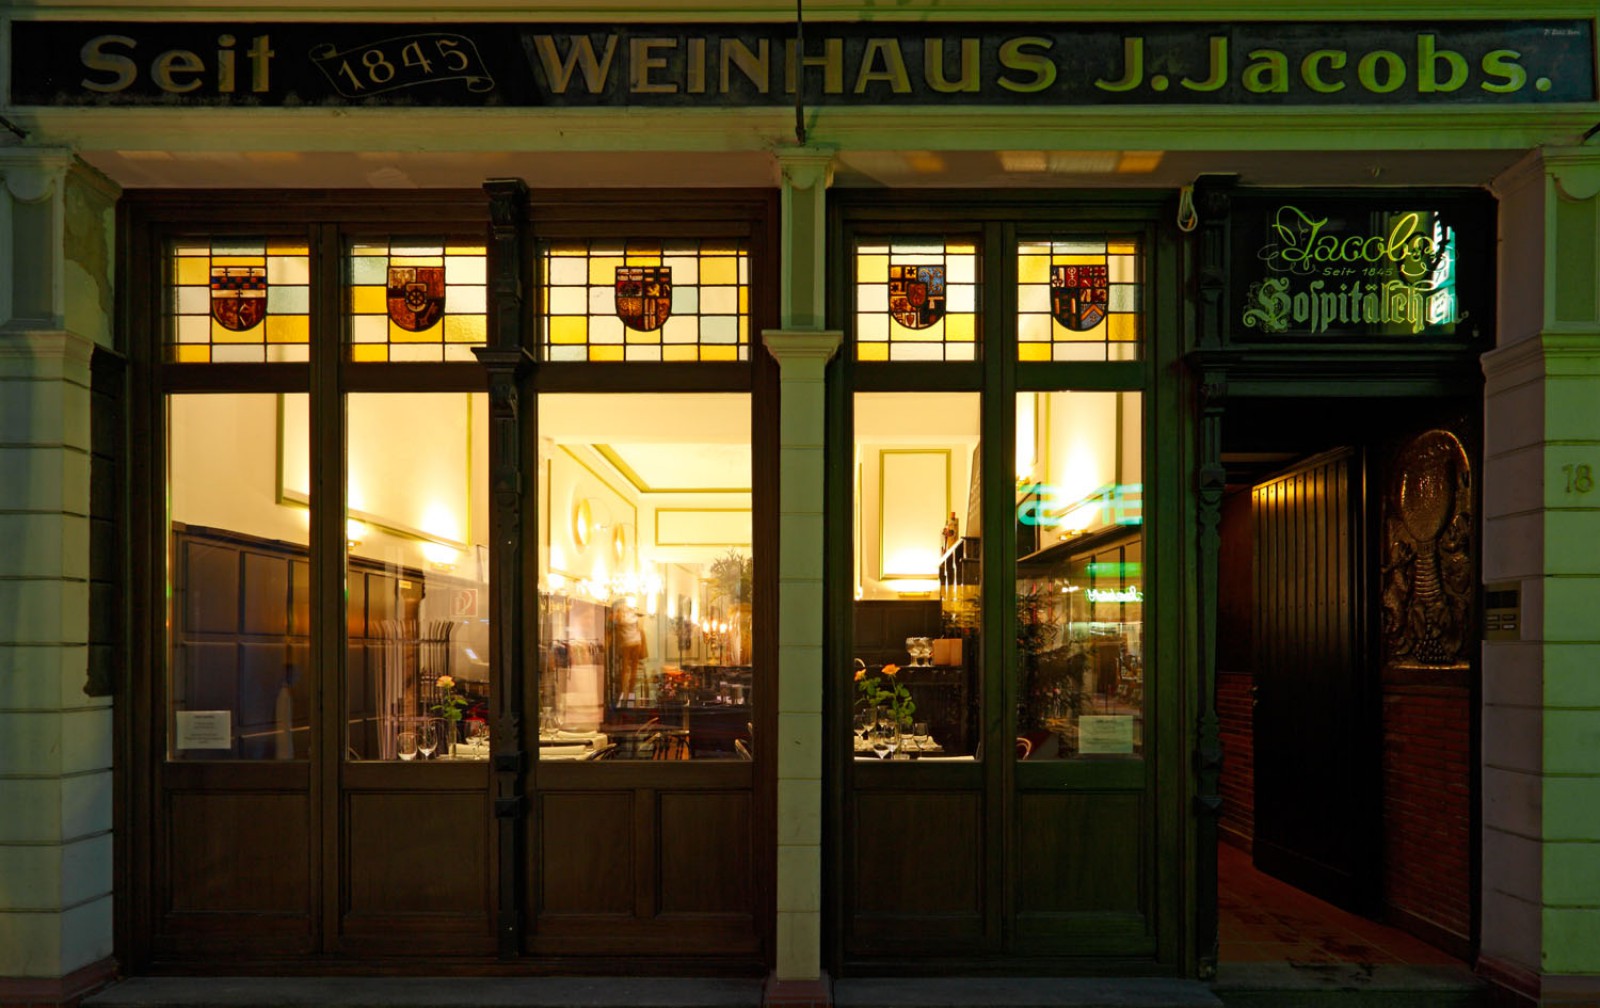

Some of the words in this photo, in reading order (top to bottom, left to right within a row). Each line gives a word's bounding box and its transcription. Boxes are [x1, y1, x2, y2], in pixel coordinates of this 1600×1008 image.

[80, 34, 273, 94] Seit
[338, 40, 468, 91] 1845
[532, 35, 1057, 95] WEINHAUS
[1322, 267, 1355, 276] Seit
[1361, 267, 1393, 277] 1845
[1562, 464, 1594, 494] 18
